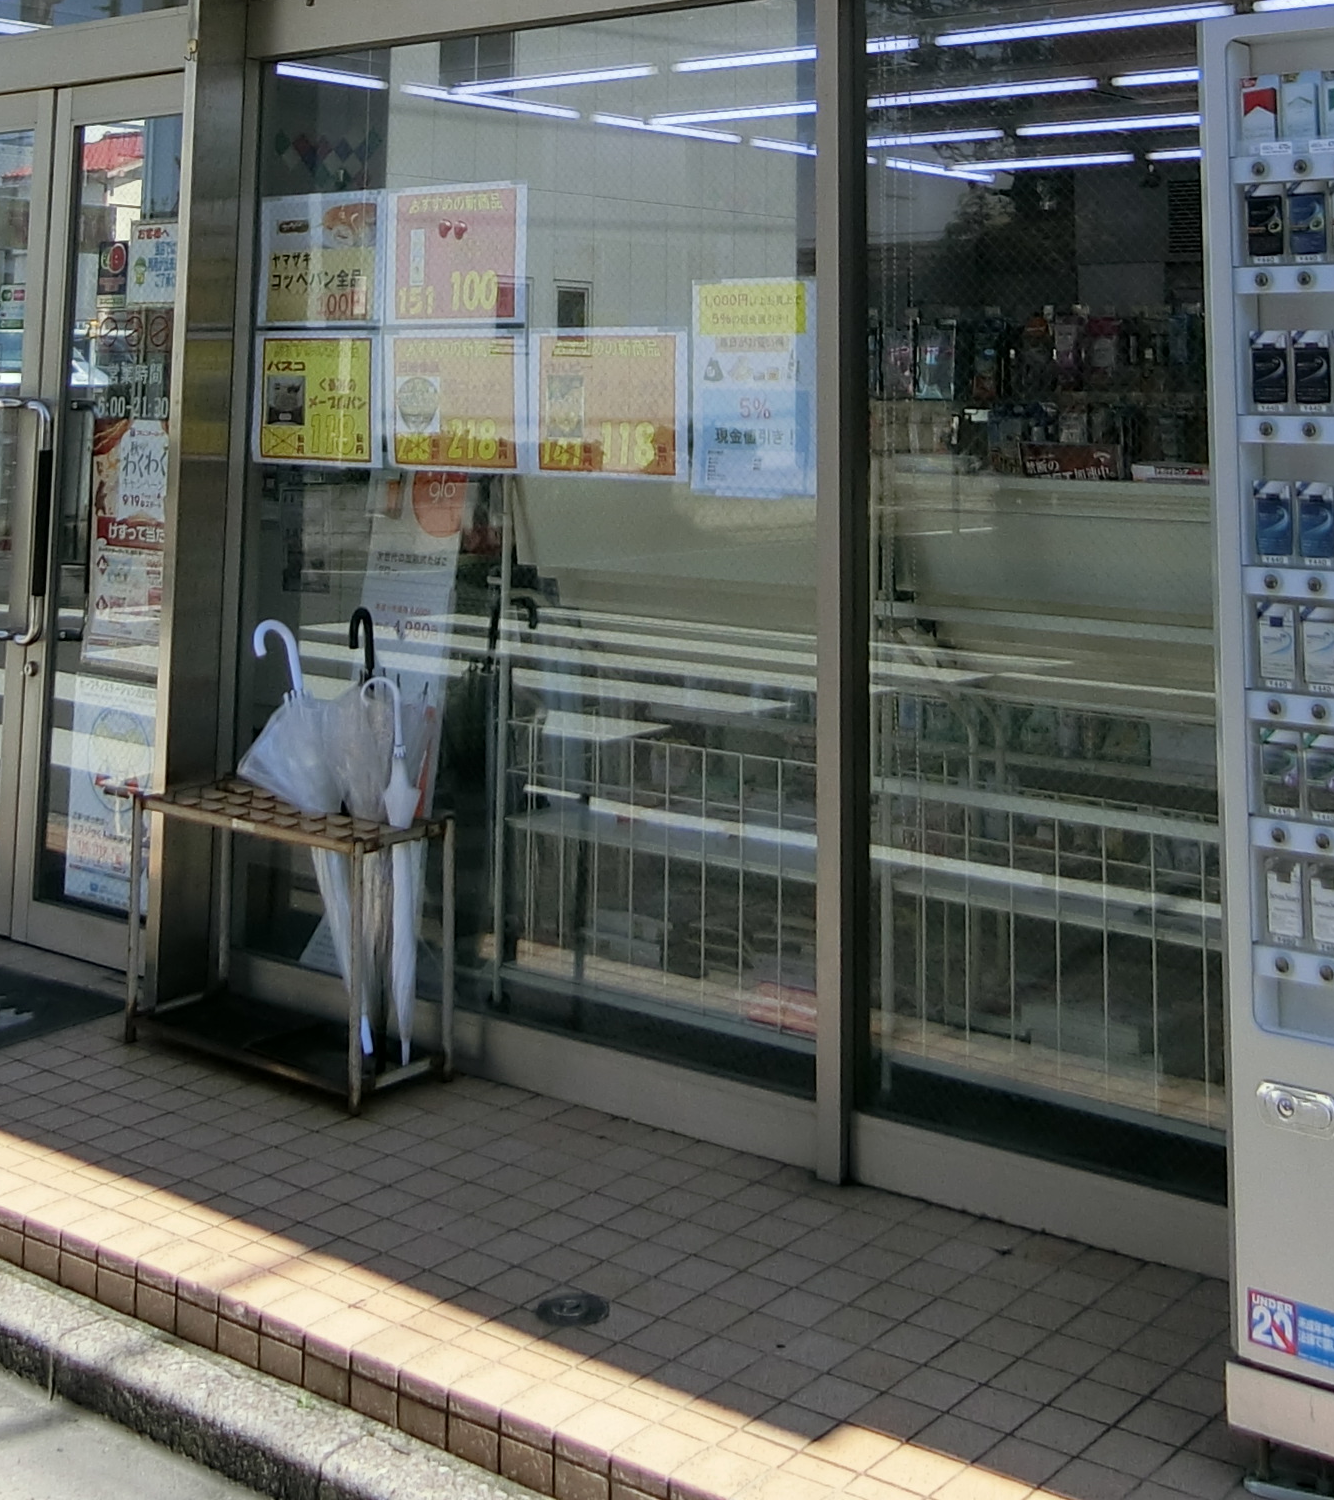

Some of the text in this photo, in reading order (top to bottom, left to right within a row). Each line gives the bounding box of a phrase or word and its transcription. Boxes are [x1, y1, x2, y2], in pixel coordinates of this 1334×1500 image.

[272, 252, 311, 269] ヤマザキ
[272, 269, 362, 289] コッペパン全品
[451, 270, 498, 311] 100
[107, 363, 163, 386] 営業時間
[267, 360, 307, 372] パスコ
[739, 397, 771, 419] 5%
[601, 420, 656, 466] 118
[122, 450, 167, 478] わくわく
[429, 472, 456, 504] glo
[1251, 1292, 1293, 1315] UNDER
[1252, 1304, 1293, 1350] 20
